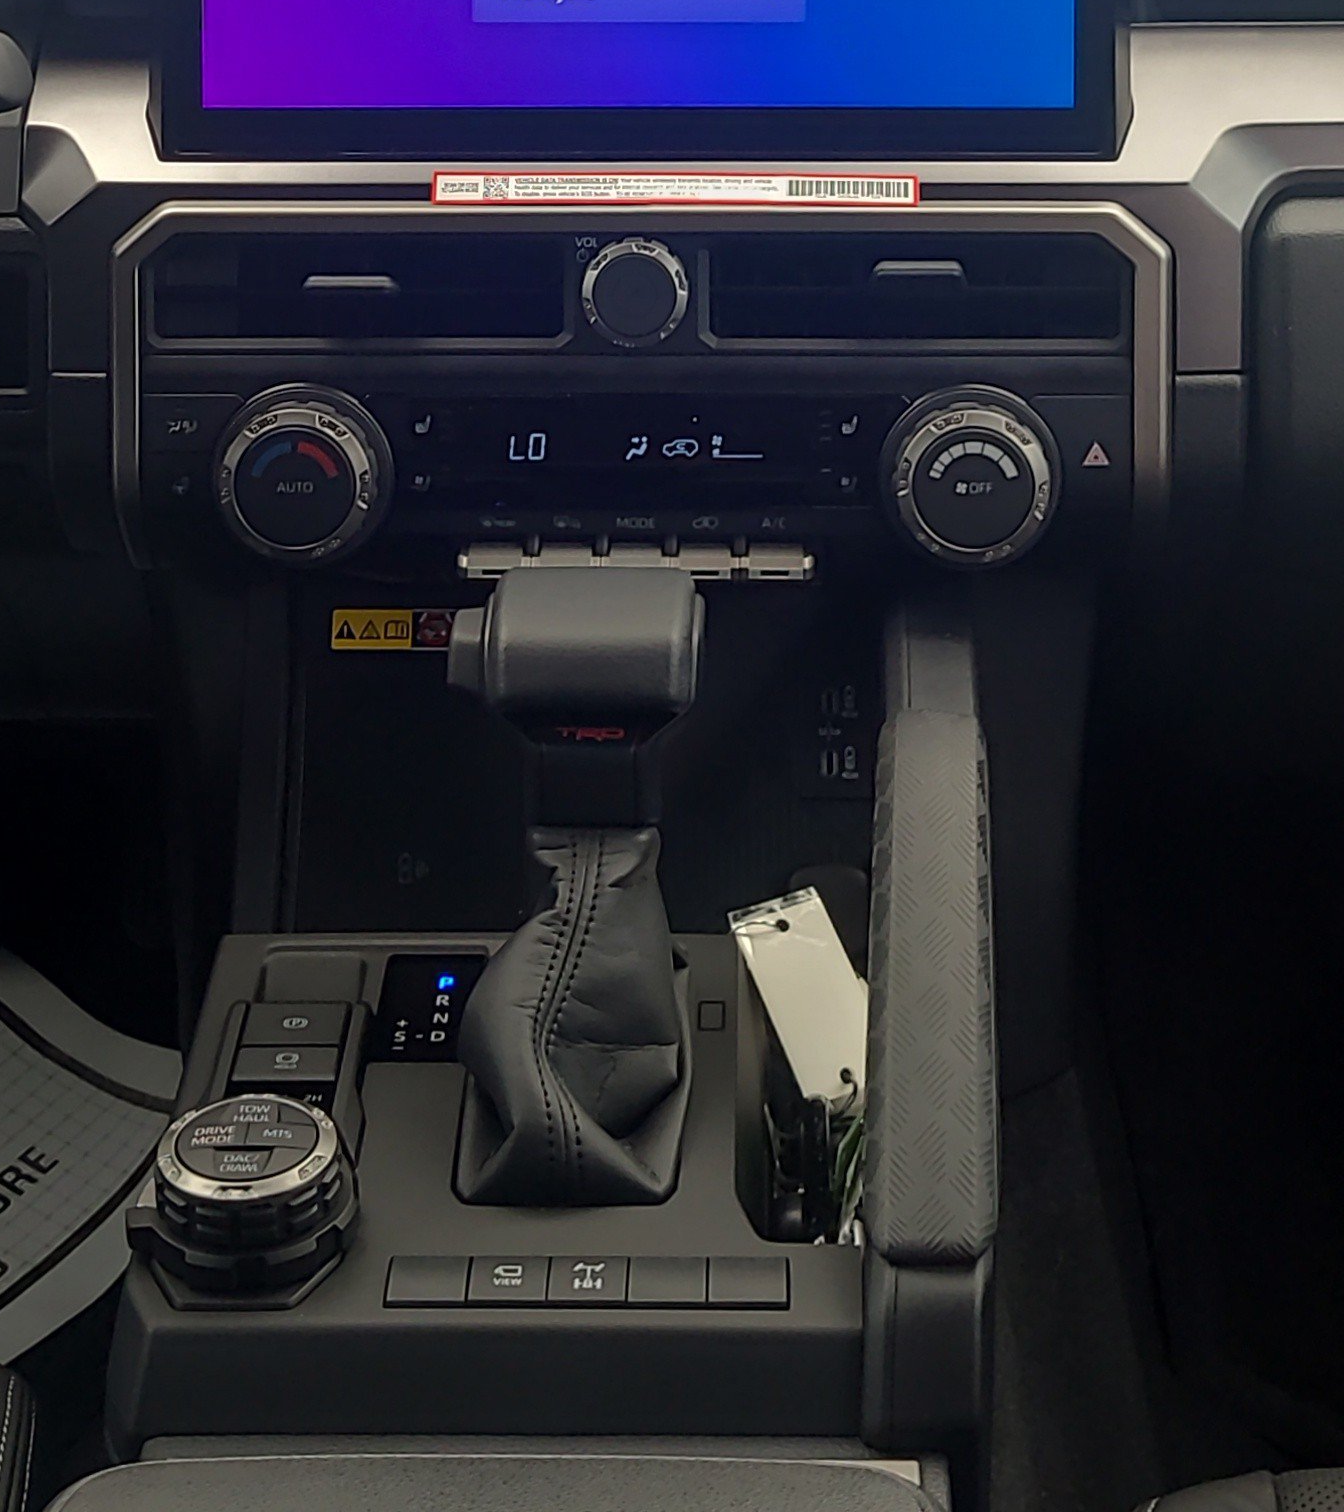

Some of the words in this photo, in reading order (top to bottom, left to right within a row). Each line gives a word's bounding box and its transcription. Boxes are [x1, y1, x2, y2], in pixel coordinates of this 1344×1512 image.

[574, 237, 598, 248] VOL
[508, 433, 546, 460] LO
[276, 480, 314, 494] AUTO
[968, 482, 994, 495] OFF
[615, 517, 655, 529] MODE
[761, 517, 785, 530] A/C
[555, 725, 626, 742] TRD
[438, 975, 455, 990] P
[436, 994, 450, 1007] R
[433, 1013, 449, 1024] N
[394, 1030, 407, 1043] S
[430, 1030, 446, 1042] D
[239, 1104, 272, 1114] TOW
[233, 1114, 270, 1123] HAUL
[194, 1124, 237, 1137] DRIVE
[191, 1134, 236, 1146] MODE
[223, 1154, 261, 1164] DAC/
[219, 1163, 259, 1173] CRAWL
[493, 1277, 523, 1286] VIEW
